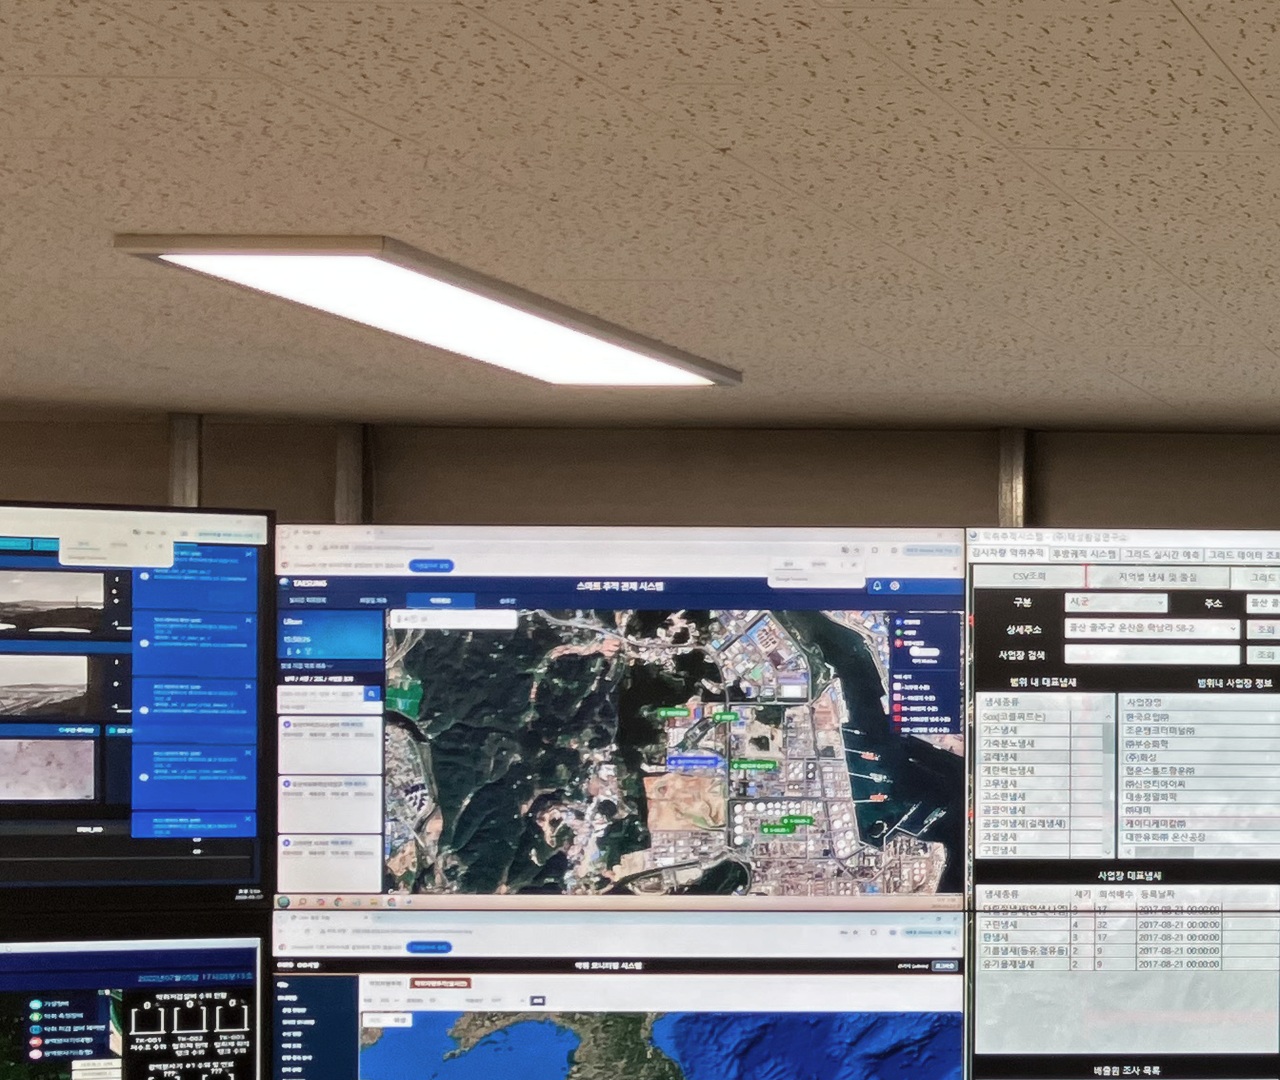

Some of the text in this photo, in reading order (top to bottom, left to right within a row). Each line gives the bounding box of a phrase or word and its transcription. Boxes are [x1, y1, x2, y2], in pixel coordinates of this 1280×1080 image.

[1090, 549, 1117, 559] 시스템
[1126, 551, 1151, 560] 그리드
[1153, 551, 1179, 560] 실시간
[1208, 551, 1235, 560] 그리드
[1237, 550, 1263, 560] 데이터
[1012, 572, 1047, 581] CSV조회
[1119, 572, 1145, 583] 지역별
[1148, 572, 1165, 583] 냄새
[1168, 573, 1177, 583] 및
[1250, 573, 1278, 582] 그리드
[576, 581, 602, 591] 스마트
[639, 581, 664, 592] 시스템
[1013, 597, 1032, 608] 구분
[1204, 599, 1223, 609] 주소
[1006, 624, 1042, 636] 상세주소
[1257, 625, 1276, 635] 조회
[999, 649, 1046, 661] 사업장 검색
[1010, 677, 1077, 688] 범위 내 대표냄새
[1197, 678, 1273, 689] 범위내 사업장 정보
[985, 697, 1019, 706] 냄새종류
[1098, 870, 1162, 882] 사업장 대표냄새
[1074, 890, 1092, 899] 세기
[1122, 1066, 1140, 1076] 조사
[1142, 1066, 1161, 1076] 목록
